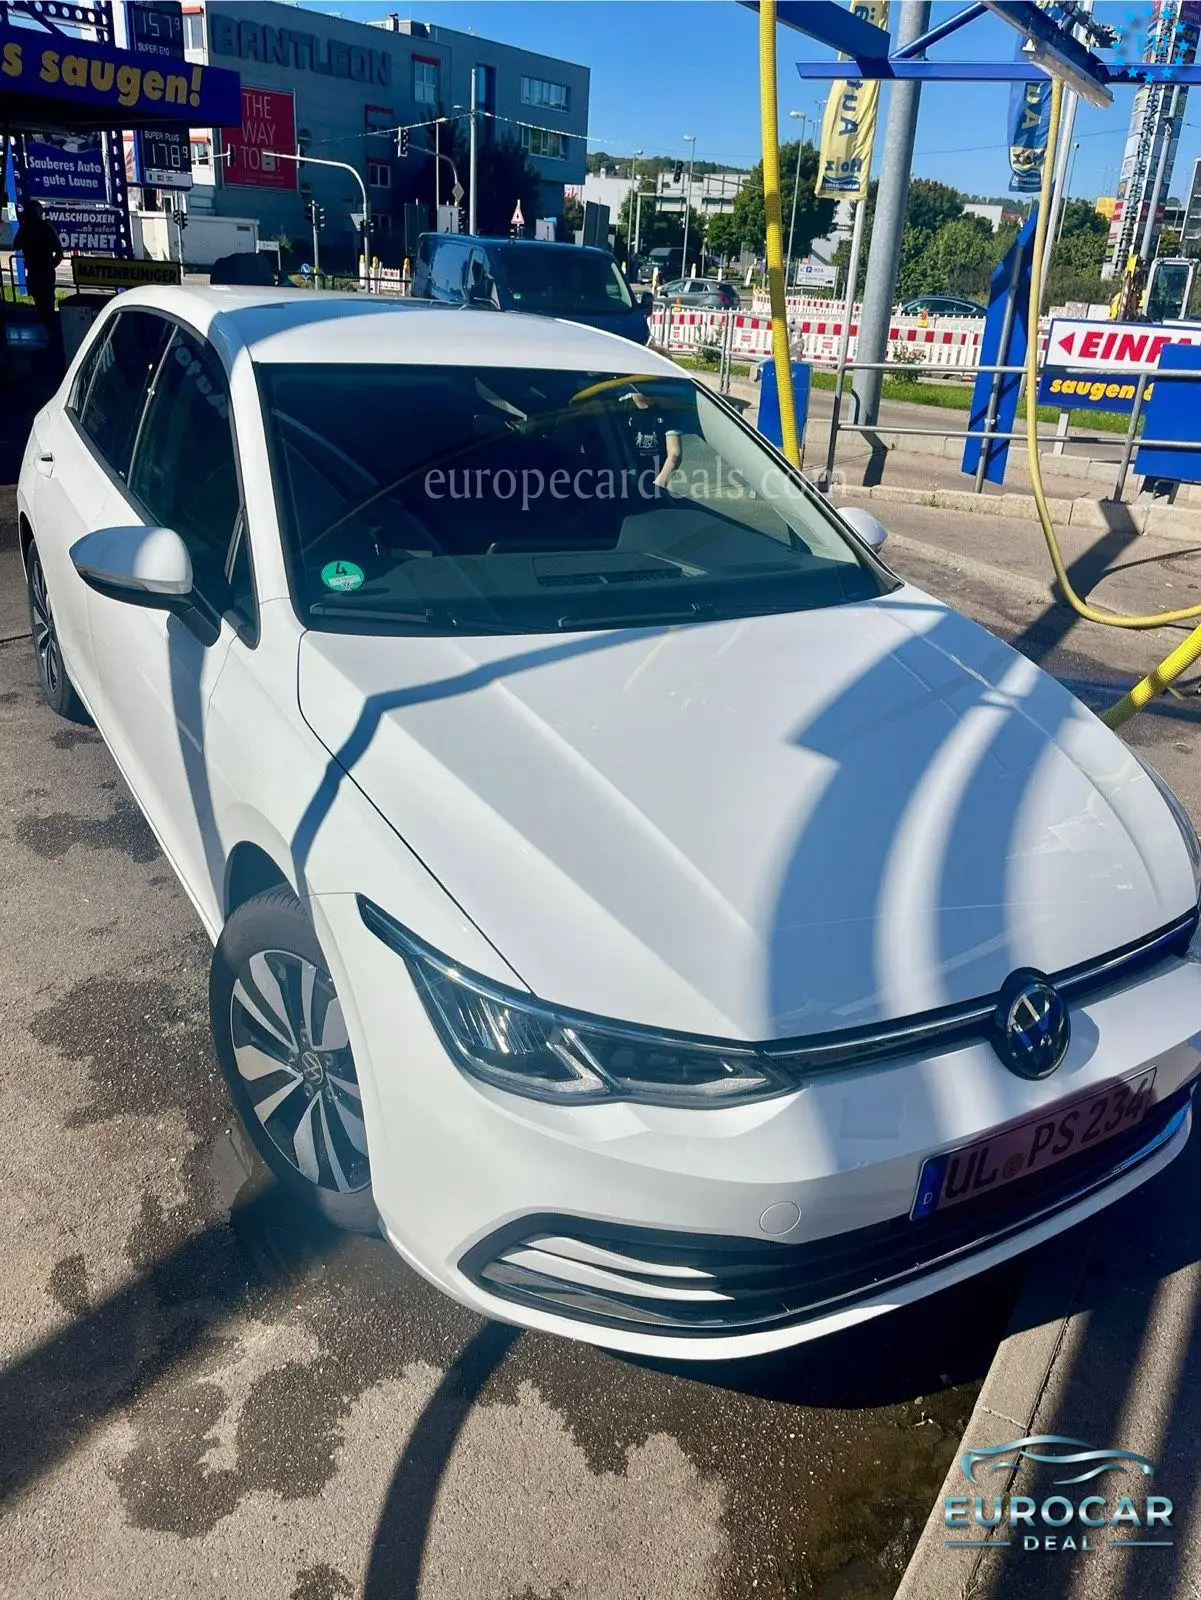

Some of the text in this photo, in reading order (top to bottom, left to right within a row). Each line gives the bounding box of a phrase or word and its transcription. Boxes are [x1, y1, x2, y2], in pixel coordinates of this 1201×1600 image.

[138, 42, 170, 56] SUPER E10
[210, 14, 392, 87] BANTLEON
[39, 49, 204, 107] saugen!
[242, 92, 272, 119] THE
[144, 130, 180, 142] SUPER PLUS
[241, 121, 276, 145] WAY
[29, 156, 102, 173] Sauberes Auto
[42, 174, 66, 187] gute
[68, 174, 99, 188] Laune
[78, 264, 177, 284] MATTENREINIGER
[1078, 331, 1192, 364] EINF
[1050, 378, 1135, 401] saugen
[335, 562, 347, 575] 4
[944, 1147, 998, 1200] UL
[1026, 1110, 1080, 1168] PS
